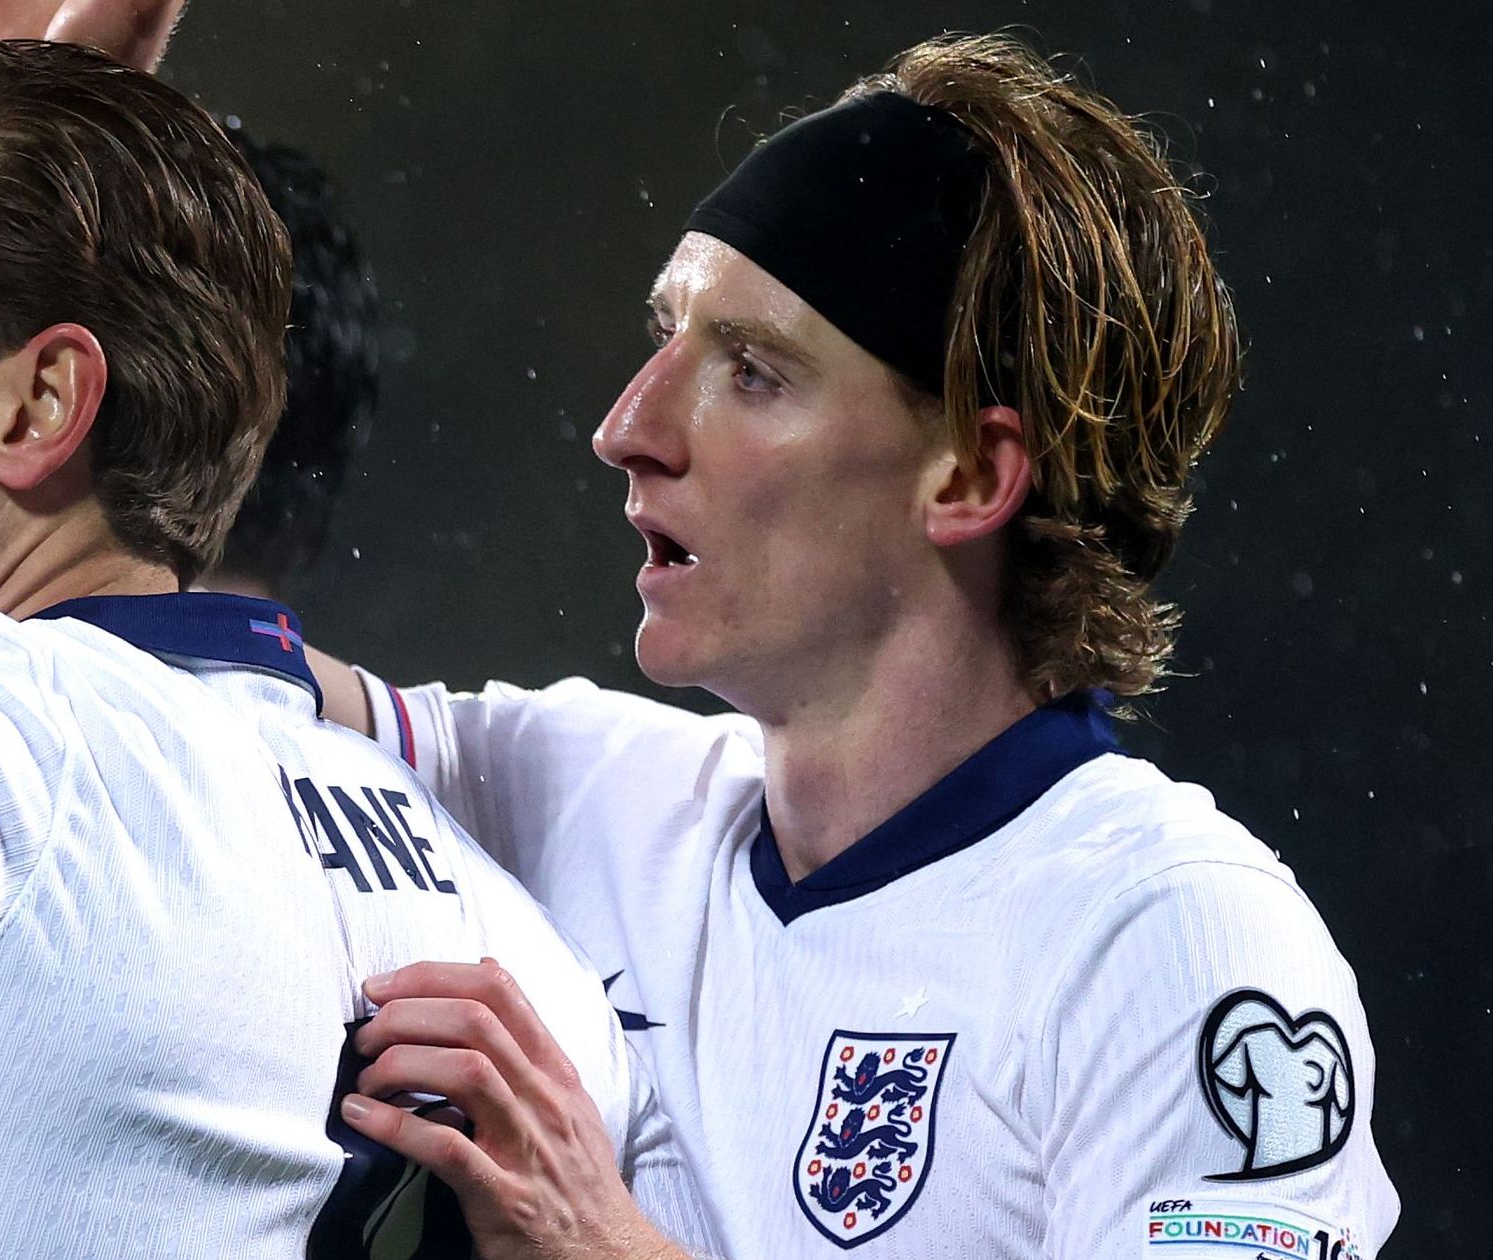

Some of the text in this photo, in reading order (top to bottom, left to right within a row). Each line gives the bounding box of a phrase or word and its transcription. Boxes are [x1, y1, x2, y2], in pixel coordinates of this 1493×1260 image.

[277, 763, 459, 895] ANE
[1149, 1200, 1193, 1213] UEFA
[1149, 1220, 1310, 1256] FOUNDATION
